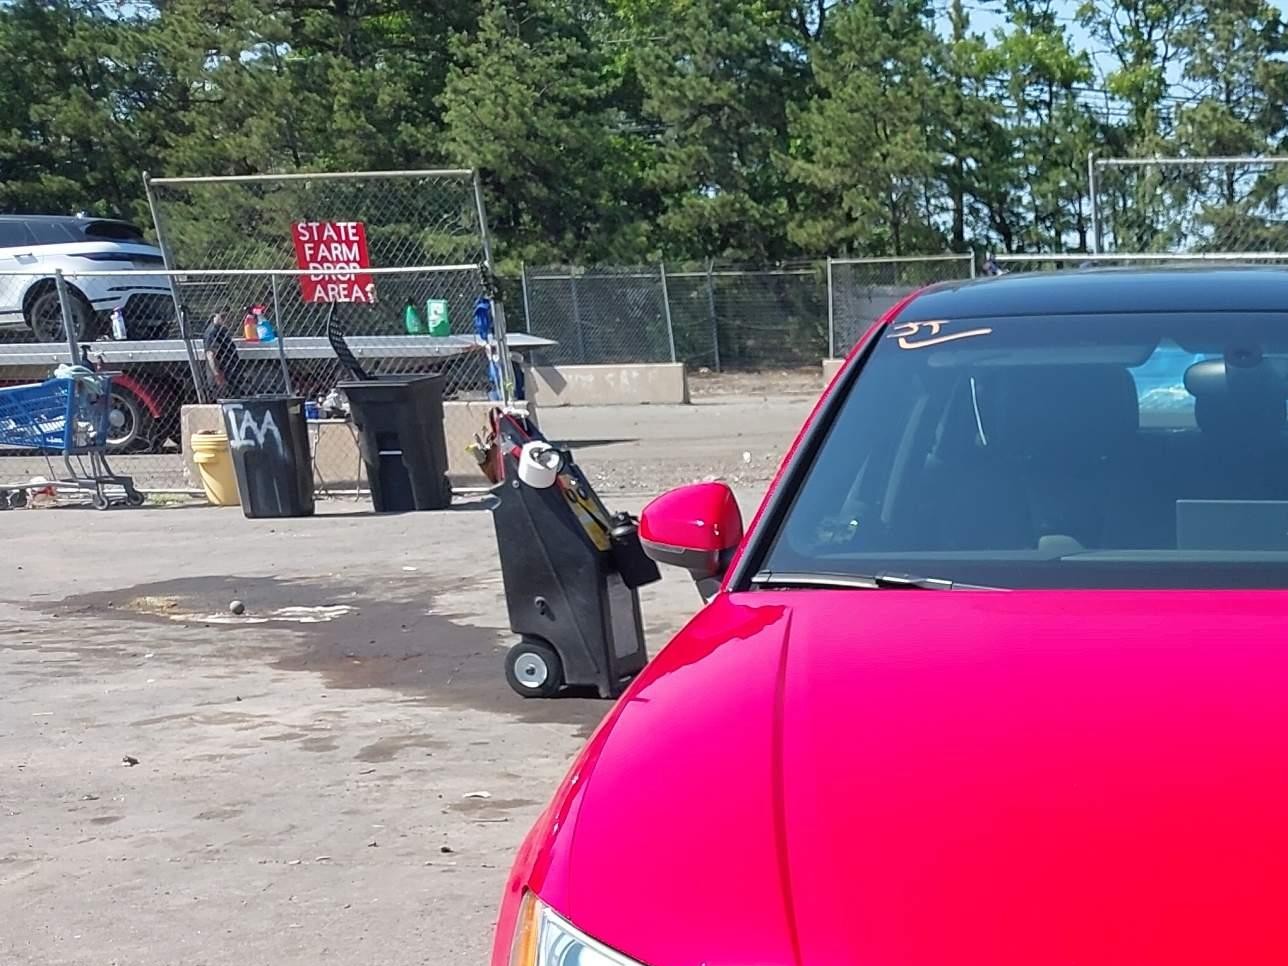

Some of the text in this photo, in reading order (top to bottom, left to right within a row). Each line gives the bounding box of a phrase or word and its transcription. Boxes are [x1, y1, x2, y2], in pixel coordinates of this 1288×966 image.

[297, 222, 360, 241] STATE
[304, 242, 361, 262] FARM
[309, 262, 361, 282] DROP
[313, 283, 366, 302] AREA
[222, 403, 285, 457] IAA
